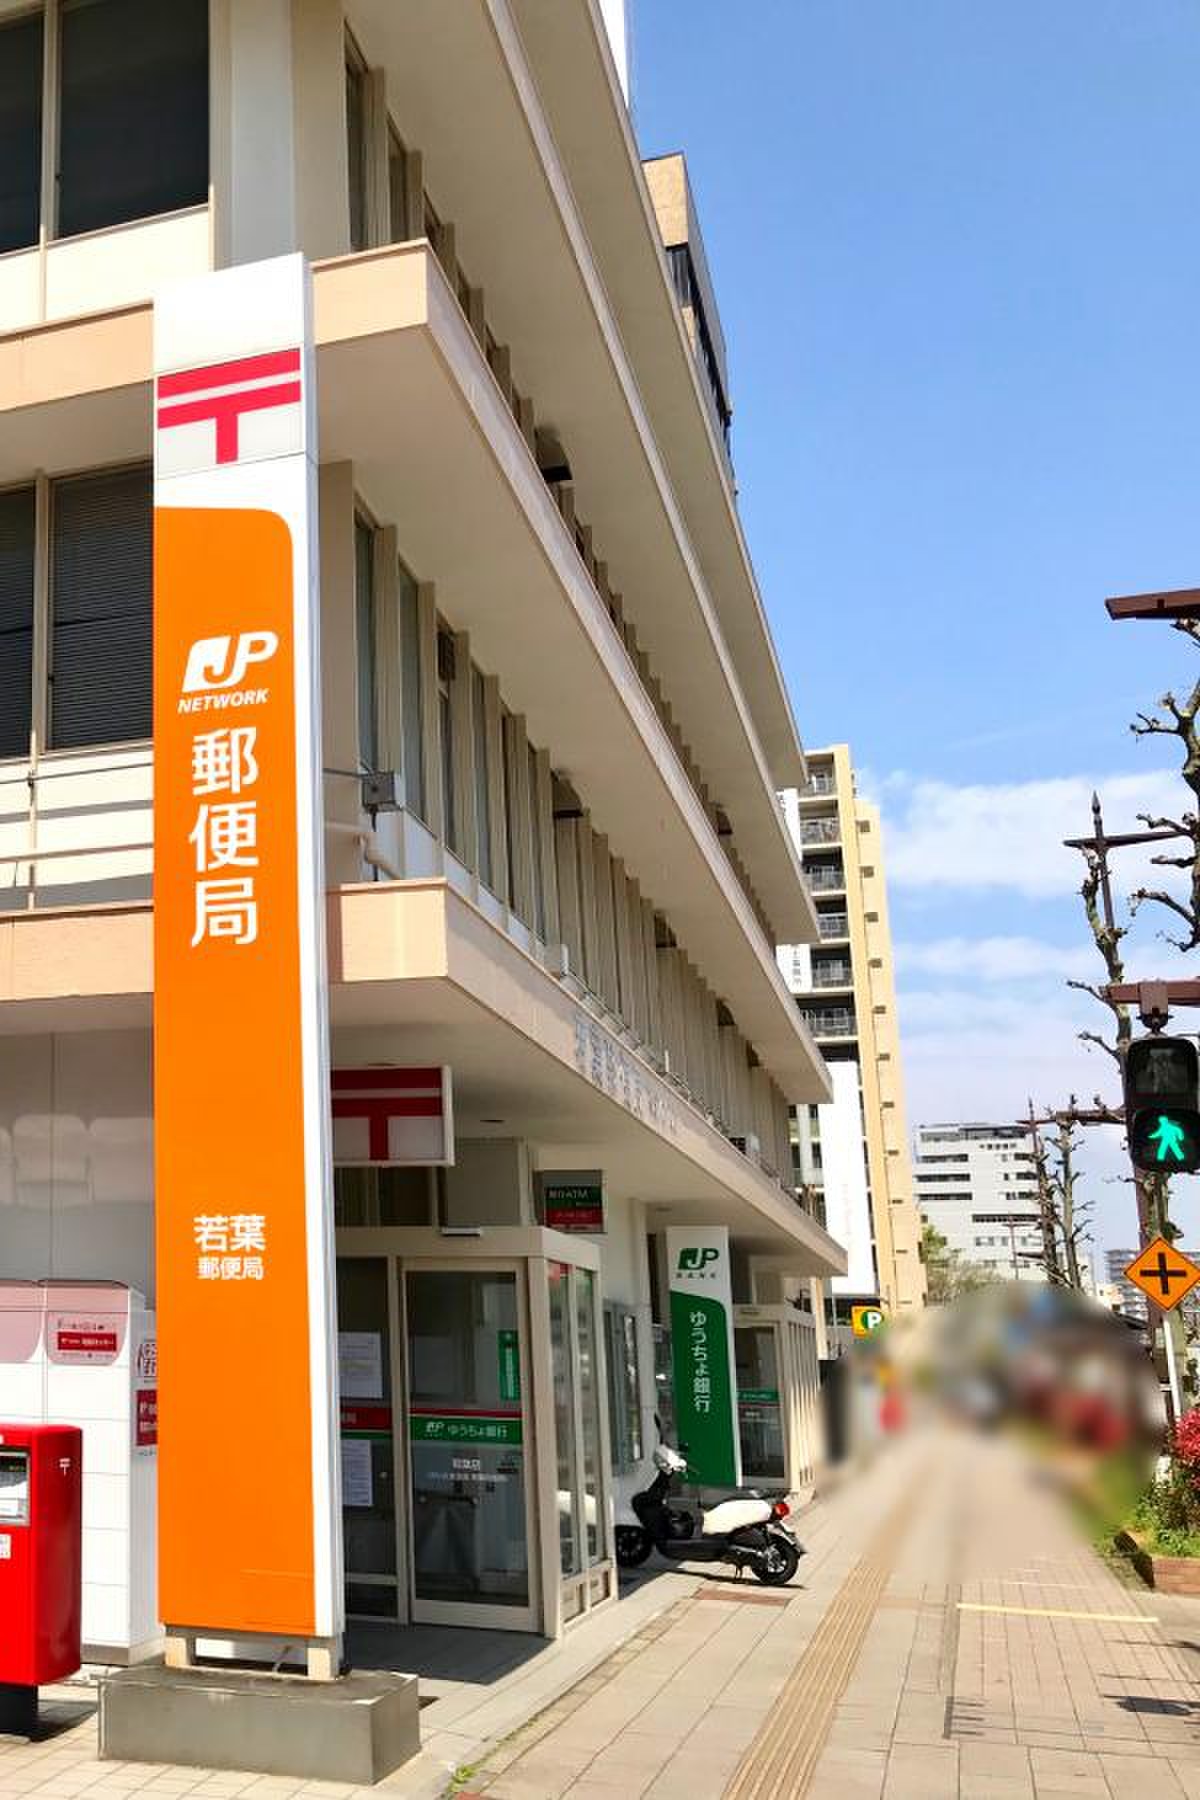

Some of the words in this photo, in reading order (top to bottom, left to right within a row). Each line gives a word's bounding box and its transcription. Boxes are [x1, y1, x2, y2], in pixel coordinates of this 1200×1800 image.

[177, 688, 269, 714] NETWORK
[188, 727, 259, 947] 郵便局
[194, 1213, 267, 1252] 若葉
[196, 1256, 265, 1280] 郵便局
[868, 1312, 881, 1328] P
[690, 1311, 711, 1413] ゆうちょ銀行
